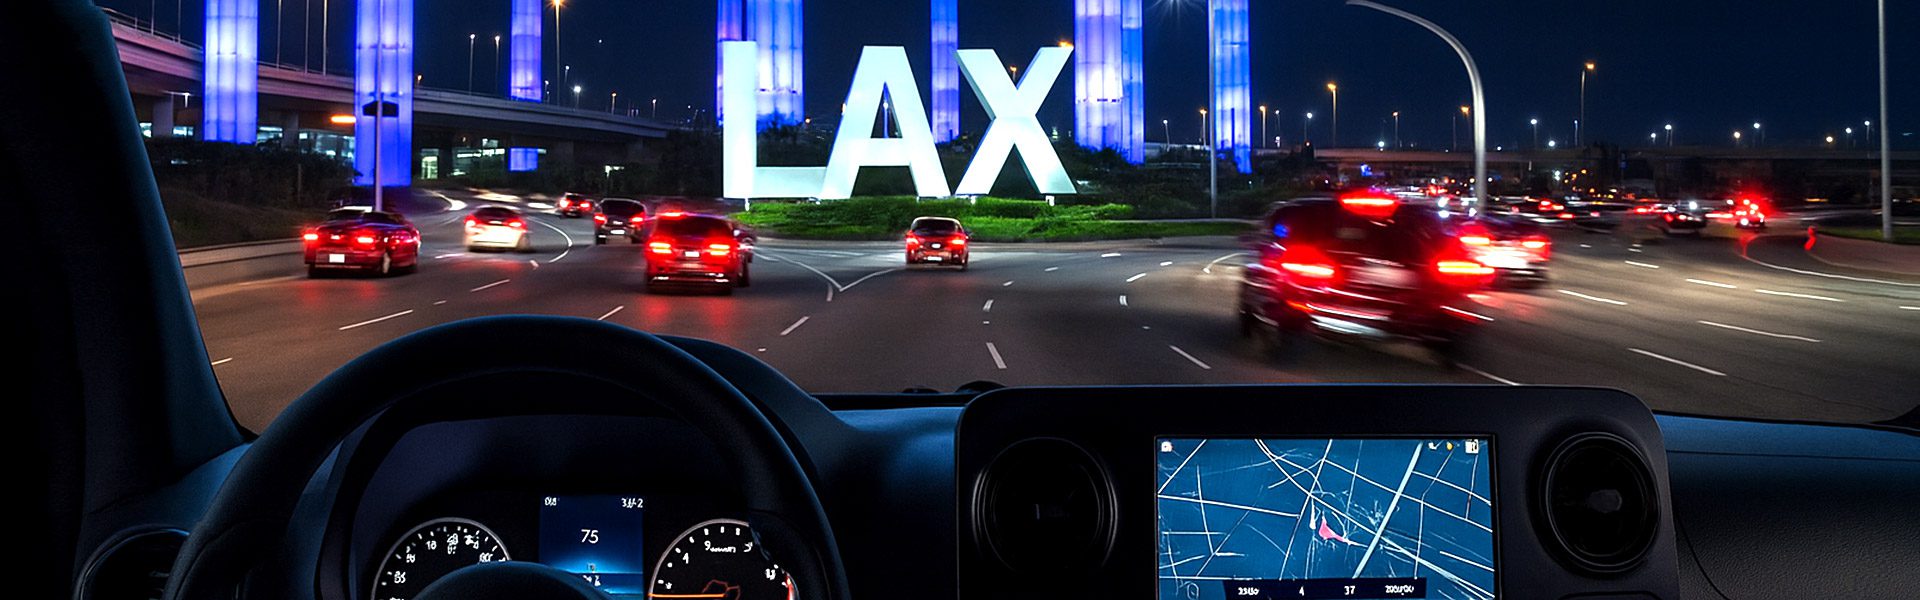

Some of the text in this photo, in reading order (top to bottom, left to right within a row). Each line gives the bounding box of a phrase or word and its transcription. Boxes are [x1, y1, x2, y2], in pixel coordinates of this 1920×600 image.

[723, 41, 1077, 200] LAX
[581, 528, 599, 544] 75
[1298, 586, 1305, 596] 4
[1344, 585, 1356, 595] 37
